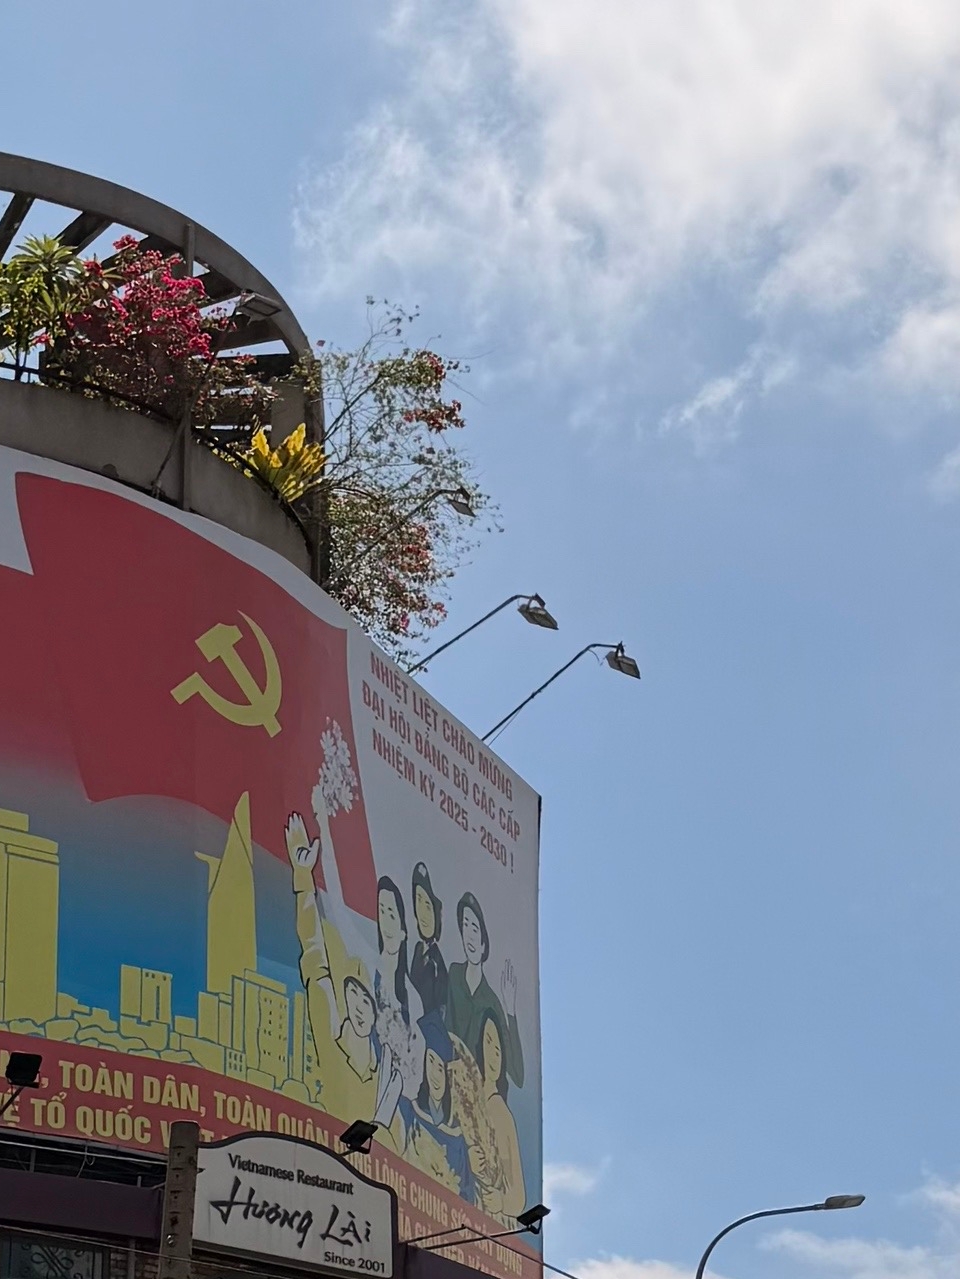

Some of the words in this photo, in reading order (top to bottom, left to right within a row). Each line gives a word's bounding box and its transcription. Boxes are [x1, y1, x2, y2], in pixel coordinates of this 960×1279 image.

[362, 680, 385, 722] ĐẠI
[389, 705, 411, 745] HỘI
[415, 731, 450, 778] ĐẢNG
[453, 763, 469, 798] BỘ
[472, 781, 496, 821] CÁC
[499, 802, 521, 842] CẤP
[371, 650, 408, 705] NHIỆT
[413, 690, 438, 733] LIỆT
[443, 718, 475, 765] CHÀO
[479, 751, 513, 802] MỪNG
[372, 728, 416, 786] NHIỆM
[419, 769, 436, 803] KỲ
[440, 790, 469, 833] 2025
[480, 825, 507, 868] 2030
[30, 1091, 67, 1129] TỔ
[76, 1104, 152, 1145] QUỐC
[58, 1060, 134, 1100] TOÀN
[143, 1074, 206, 1117] DÂN,
[214, 1090, 272, 1132] TOÀN
[277, 1113, 329, 1147] QUÂN
[410, 1182, 448, 1228] CHUNG
[228, 1153, 294, 1182] Vietnamese
[296, 1169, 354, 1196] Restaurant
[324, 1251, 355, 1268] Since
[358, 1257, 386, 1273] 2001
